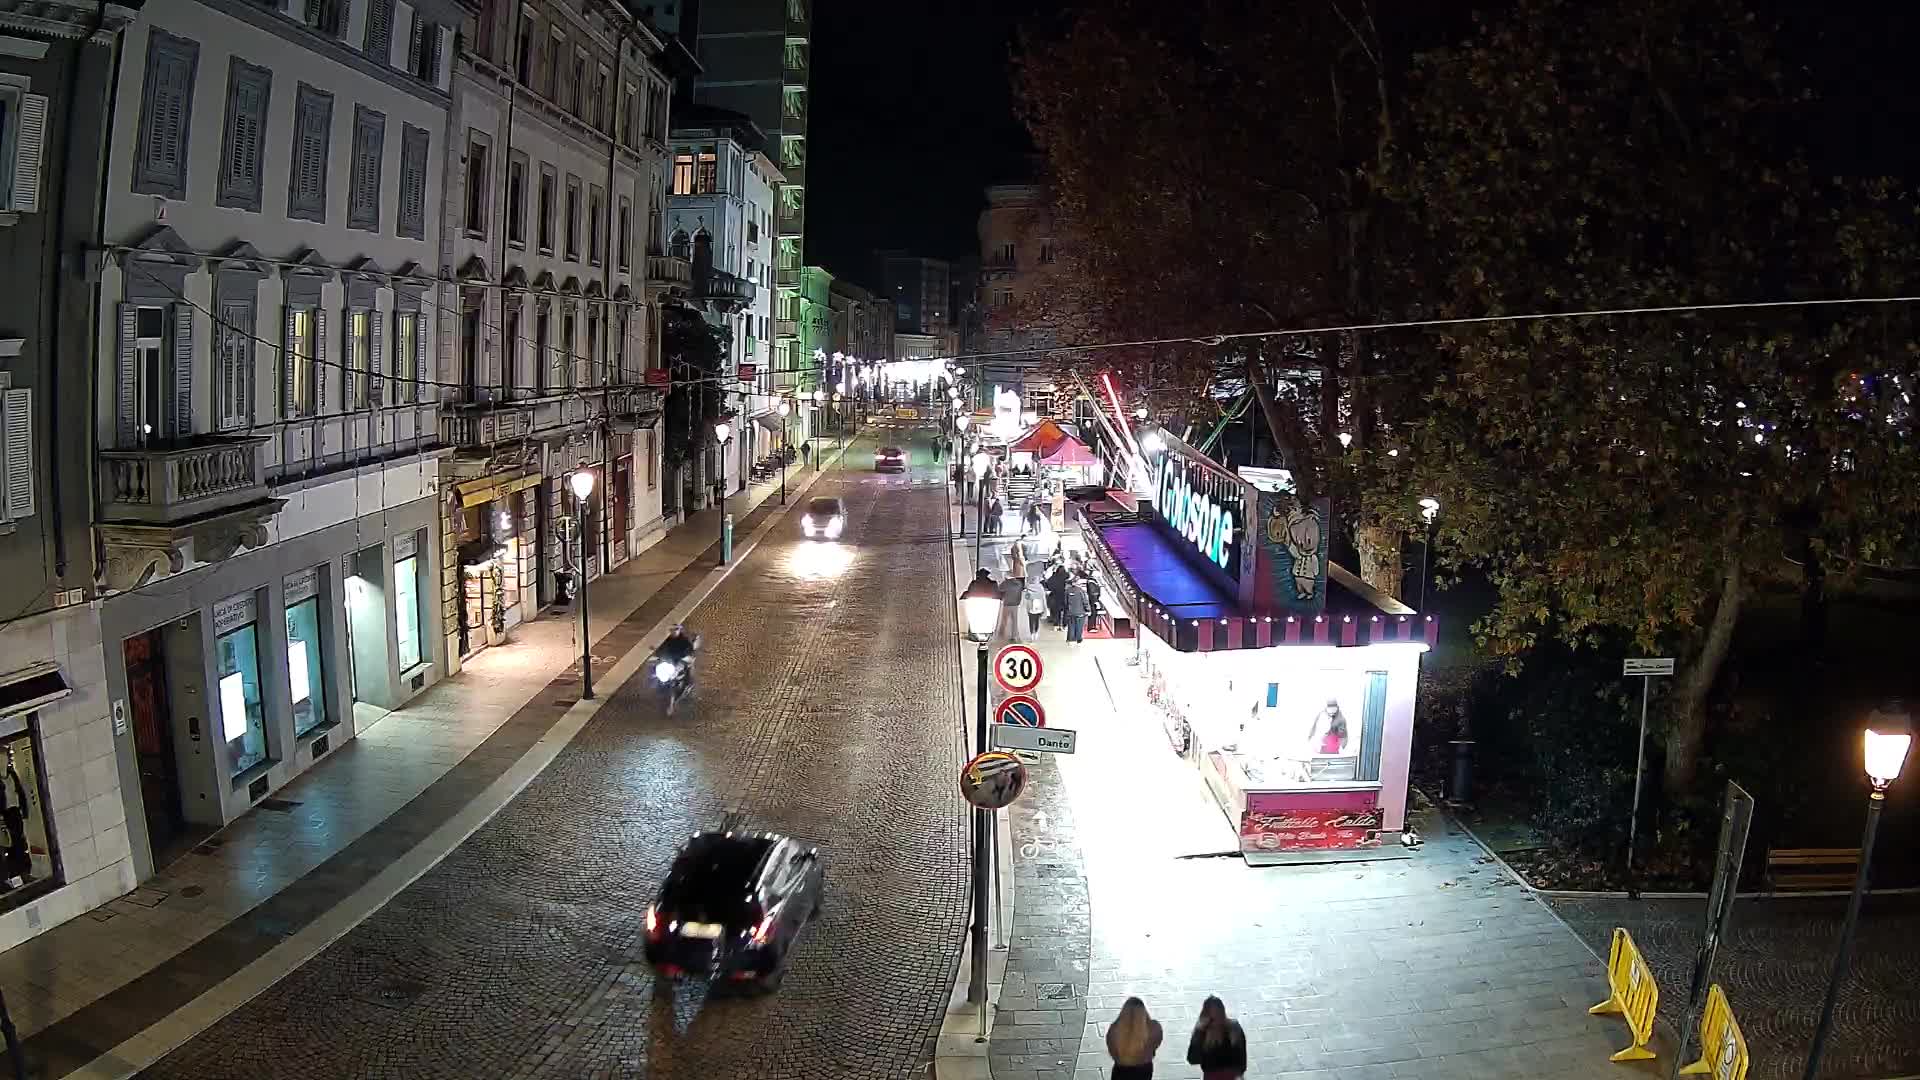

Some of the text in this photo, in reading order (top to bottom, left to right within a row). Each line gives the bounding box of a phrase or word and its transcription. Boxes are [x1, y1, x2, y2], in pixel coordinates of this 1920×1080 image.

[1162, 458, 1233, 569] Golosone
[1006, 657, 1033, 680] 30
[1038, 737, 1070, 749] Dante
